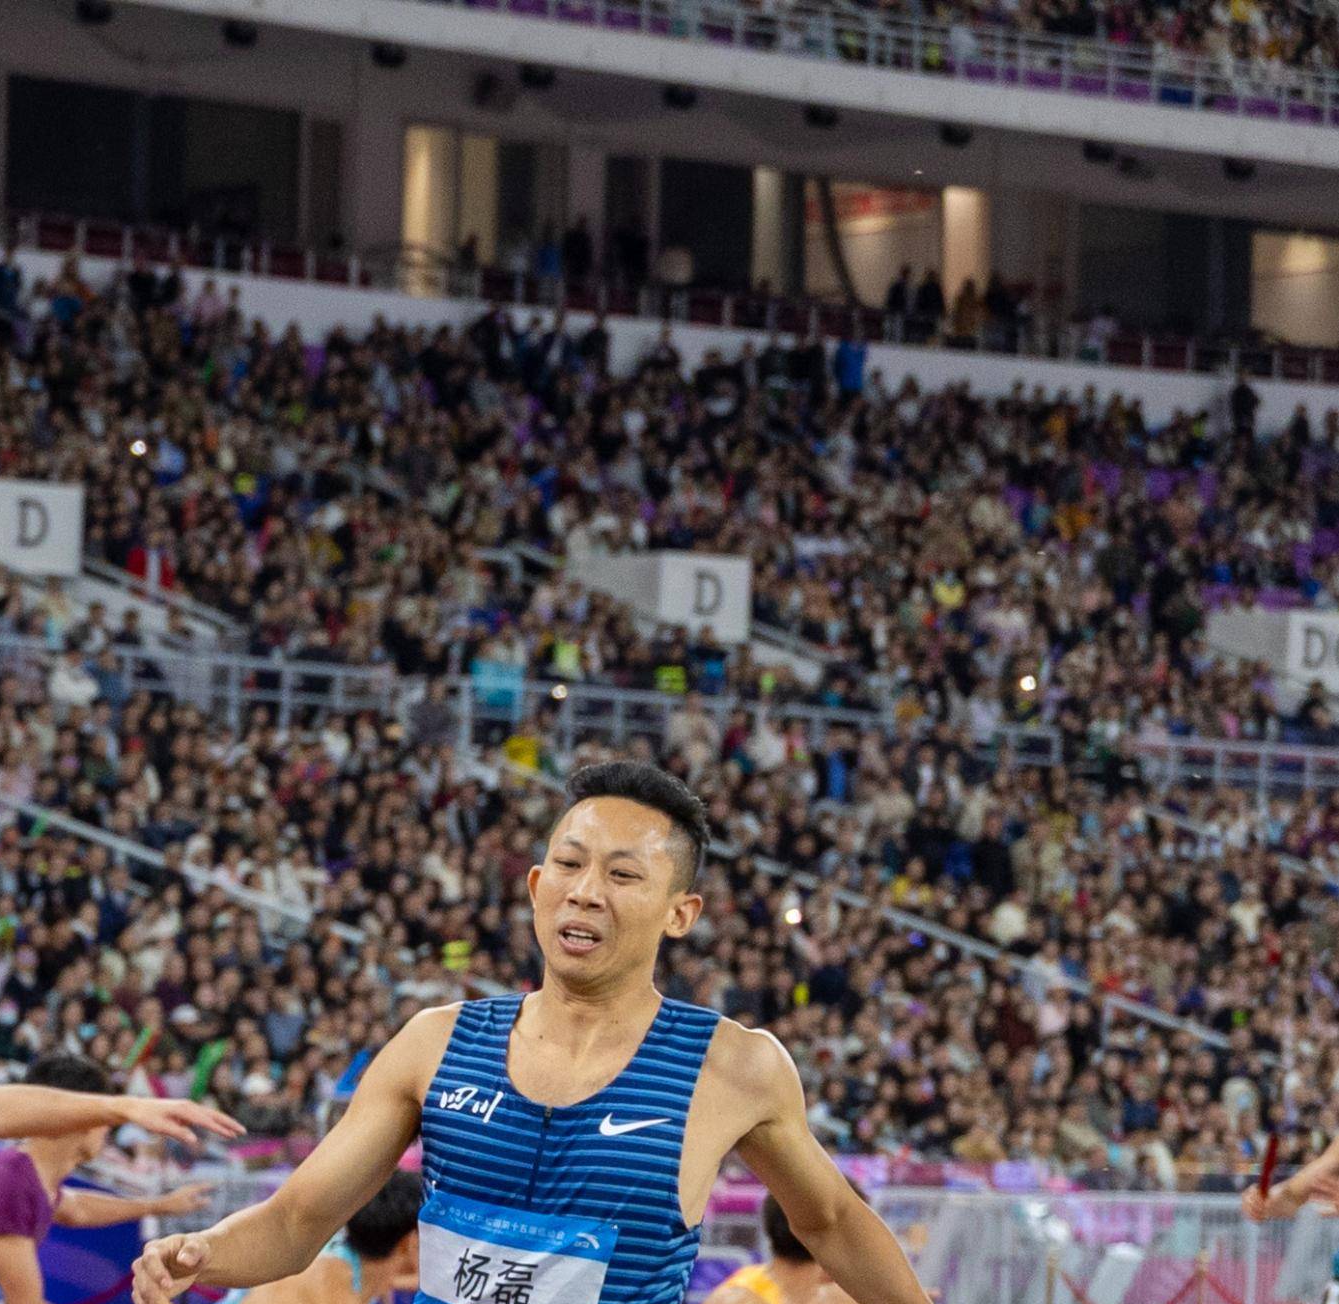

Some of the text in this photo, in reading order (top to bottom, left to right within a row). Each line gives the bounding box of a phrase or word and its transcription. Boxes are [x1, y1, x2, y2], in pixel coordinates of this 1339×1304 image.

[18, 497, 48, 548] D
[693, 569, 721, 616] D
[439, 1087, 504, 1123] 四川
